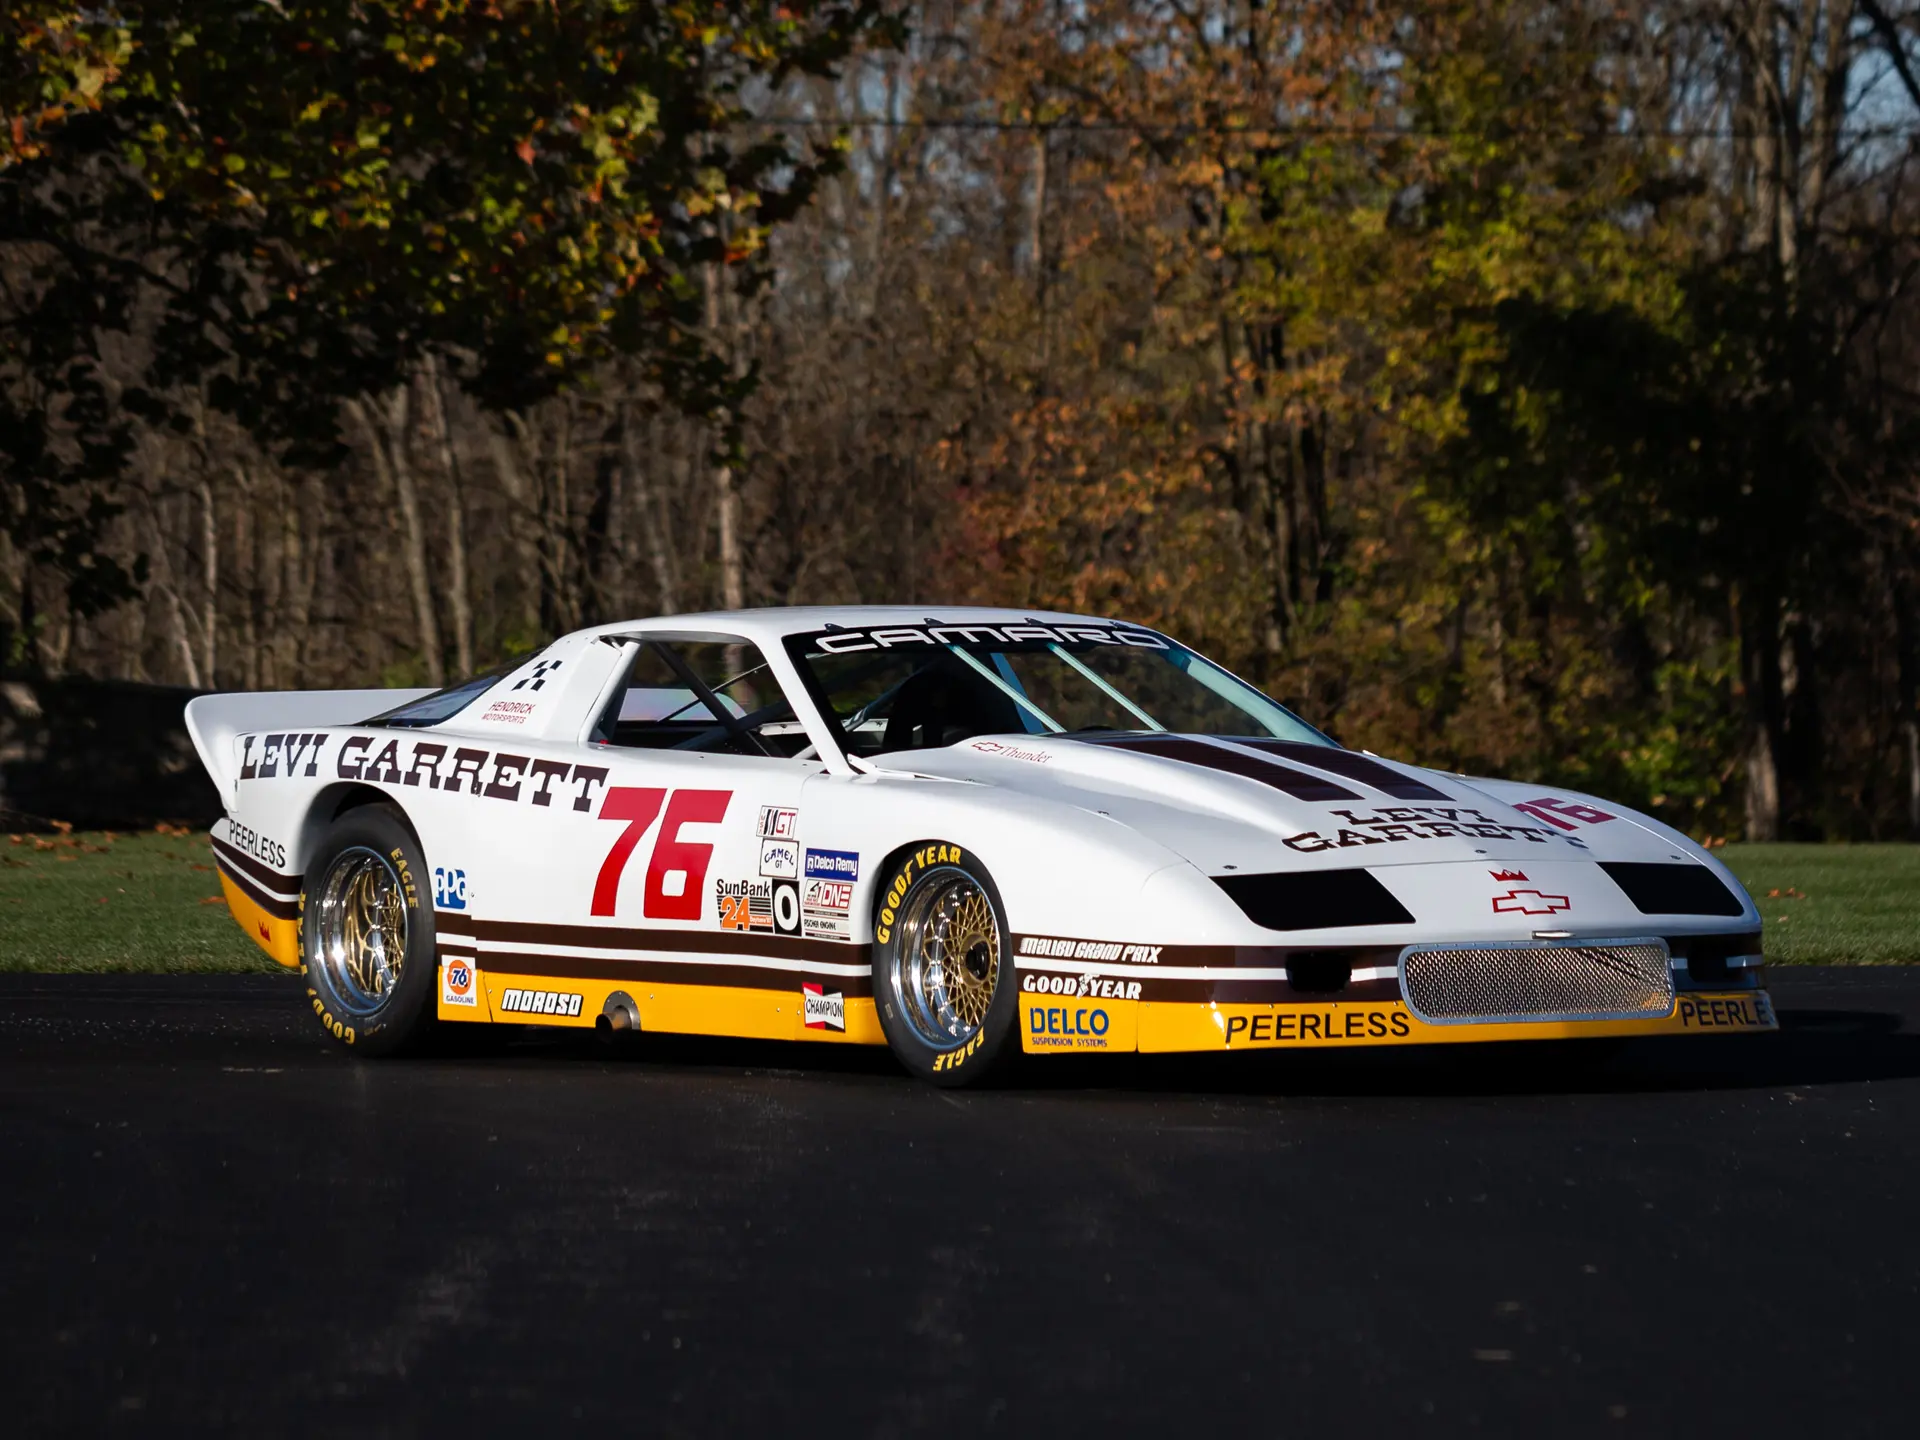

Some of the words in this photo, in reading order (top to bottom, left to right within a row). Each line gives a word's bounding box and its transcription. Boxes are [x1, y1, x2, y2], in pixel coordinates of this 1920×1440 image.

[816, 627, 1170, 654] CAMARO
[481, 713, 527, 724] MOTORSPORTS
[488, 701, 536, 715] HENDRICK
[1000, 745, 1053, 764] Thunder
[240, 733, 330, 780] LEVI
[337, 736, 610, 812] GARRETT
[776, 811, 797, 836] GT
[1329, 807, 1500, 826] LEVI
[1512, 797, 1618, 831] 76
[229, 818, 286, 868] PEERLESS
[1281, 822, 1590, 853] GARRETT
[590, 786, 734, 921] 76
[764, 848, 794, 866] CAMEL
[775, 860, 783, 869] GT
[814, 855, 835, 871] Delco
[835, 857, 858, 876] Remy
[391, 847, 419, 909] EAGLE
[716, 879, 771, 897] SunBank
[720, 895, 750, 930] 24
[1122, 945, 1163, 964] PRIX
[451, 968, 467, 986] 76
[446, 995, 474, 1005] GASOLINE
[501, 988, 583, 1017] MOROSO
[806, 998, 842, 1018] CHAMPION
[1030, 1007, 1110, 1036] DELCO
[1225, 1012, 1410, 1044] PEERLESS
[933, 1026, 984, 1071] EAGLE
[1032, 1036, 1073, 1047] SUSPENSION
[1077, 1038, 1107, 1048] SYSTEMS
